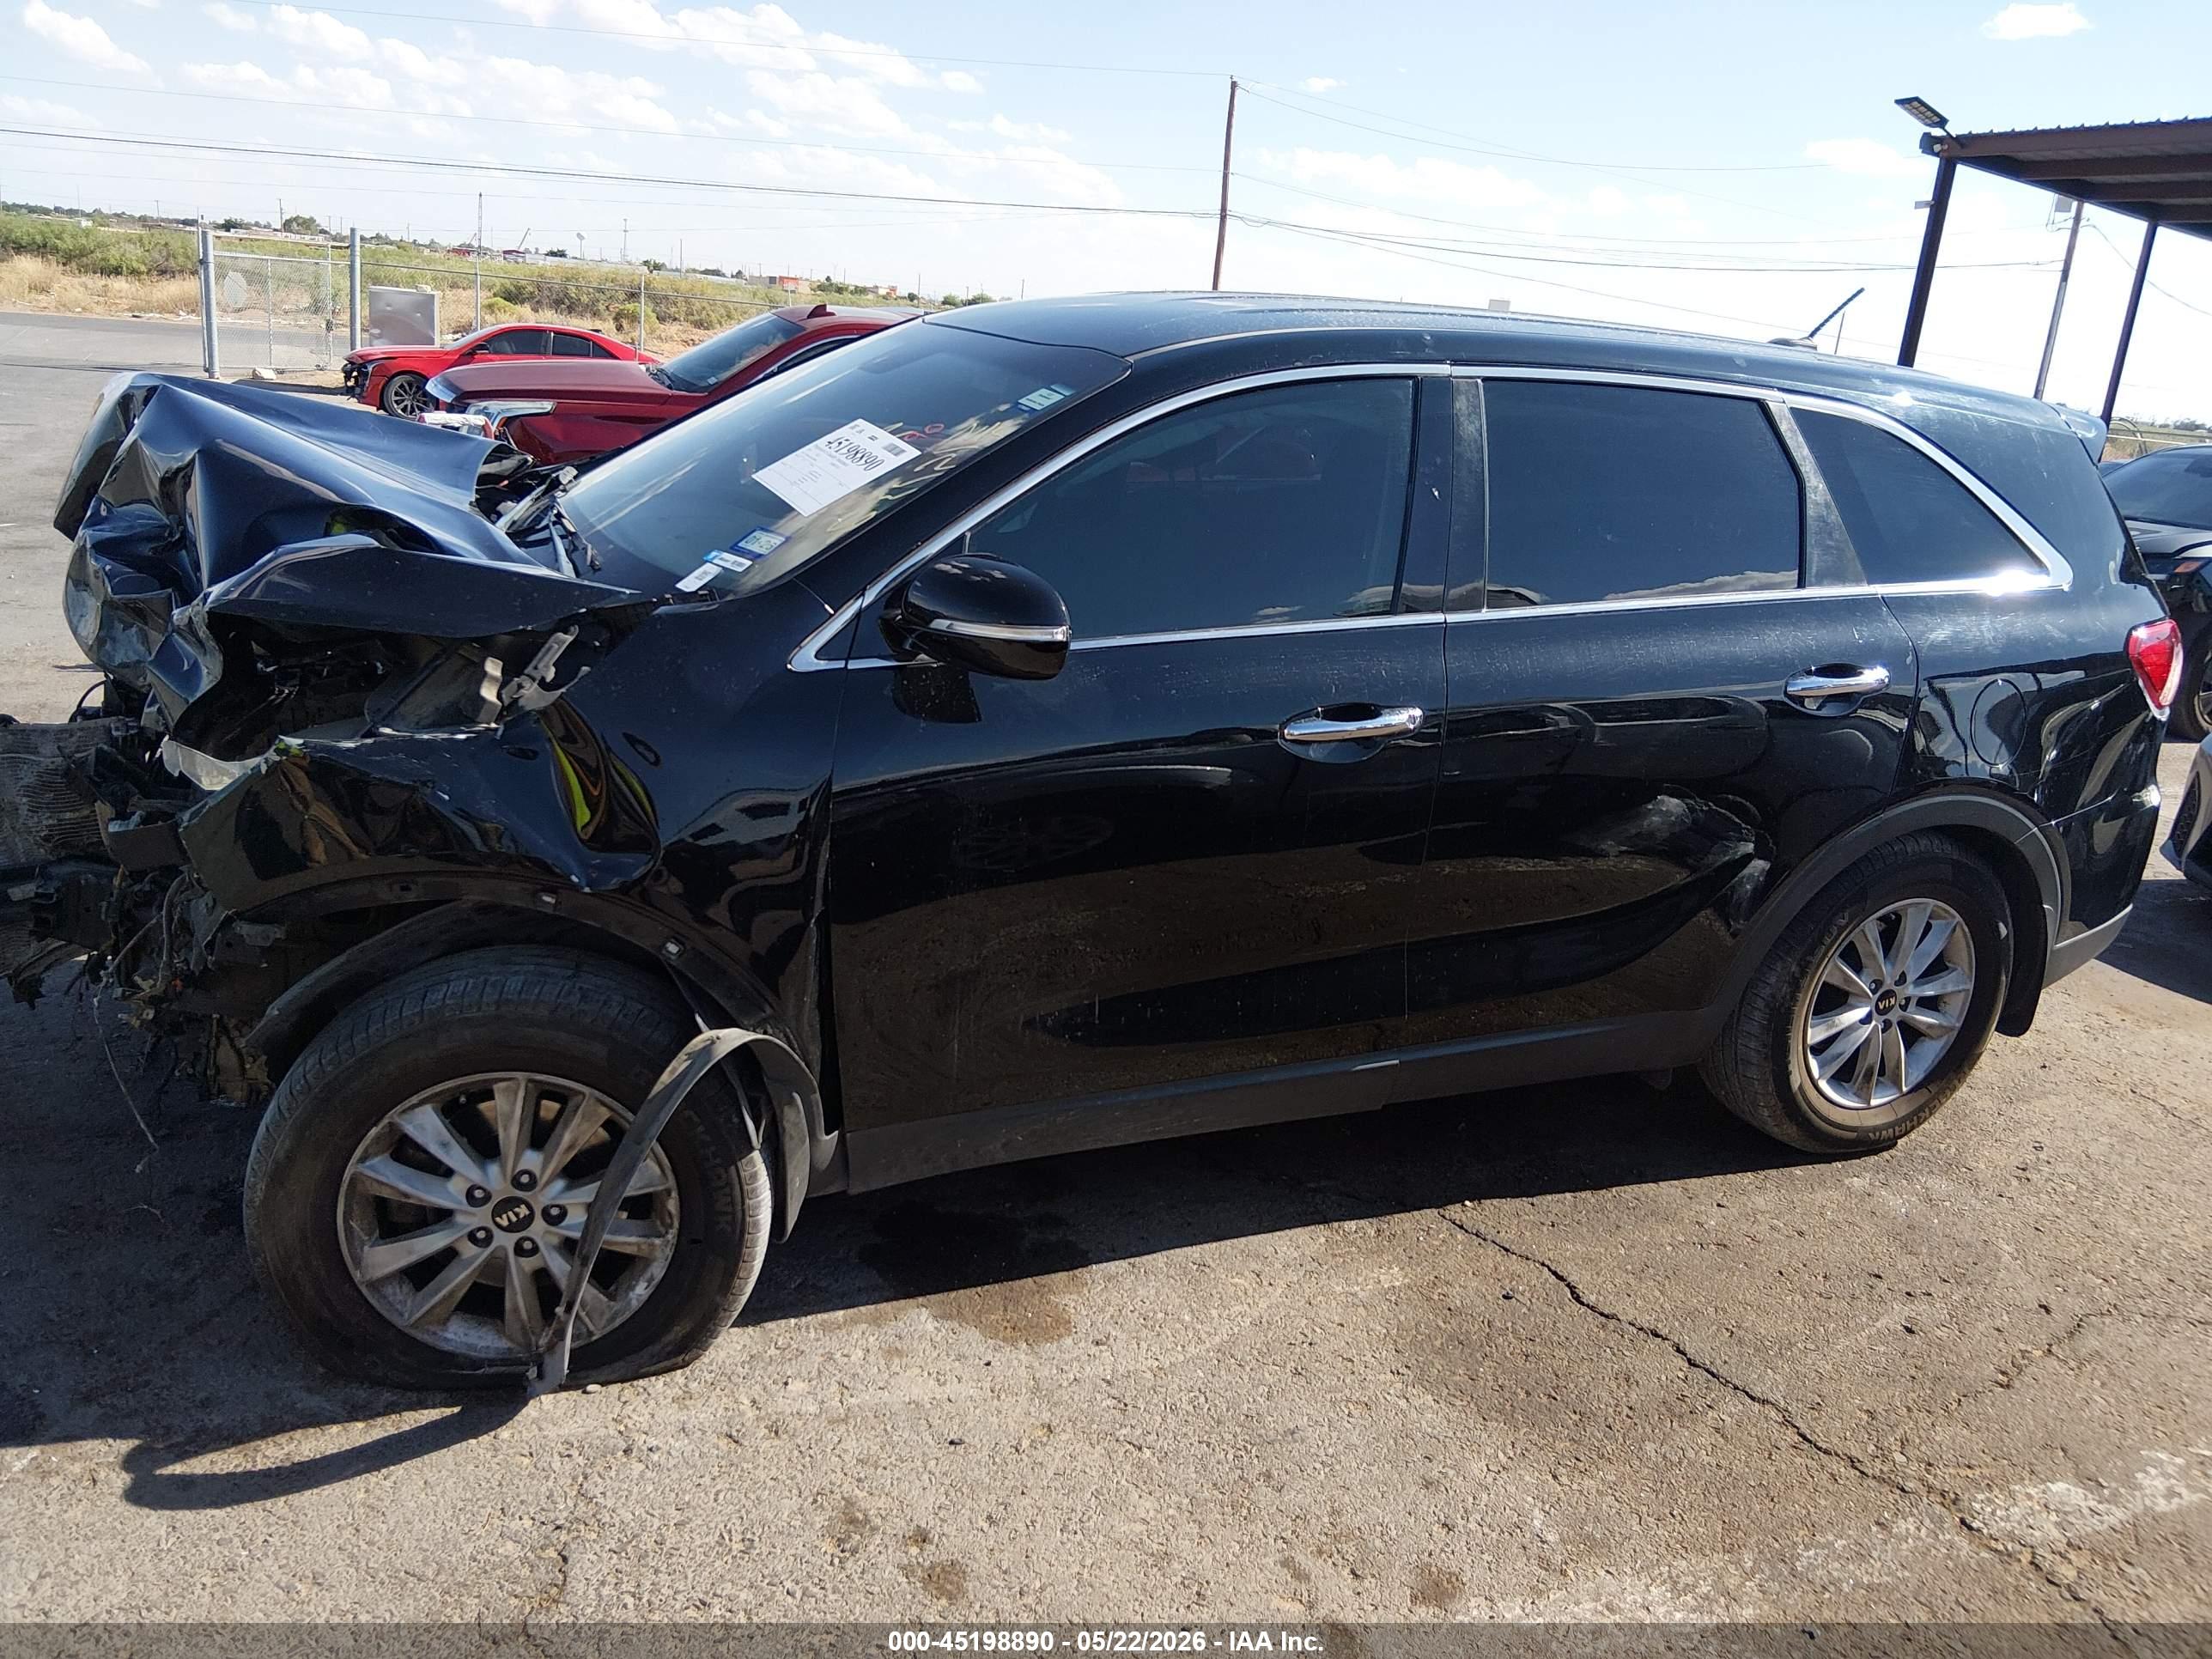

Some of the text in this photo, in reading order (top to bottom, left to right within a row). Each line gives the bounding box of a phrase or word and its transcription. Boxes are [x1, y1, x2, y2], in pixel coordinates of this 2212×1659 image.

[825, 436, 884, 471] 45198890
[1877, 996, 1896, 1010] KIA
[494, 1203, 531, 1228] KIA
